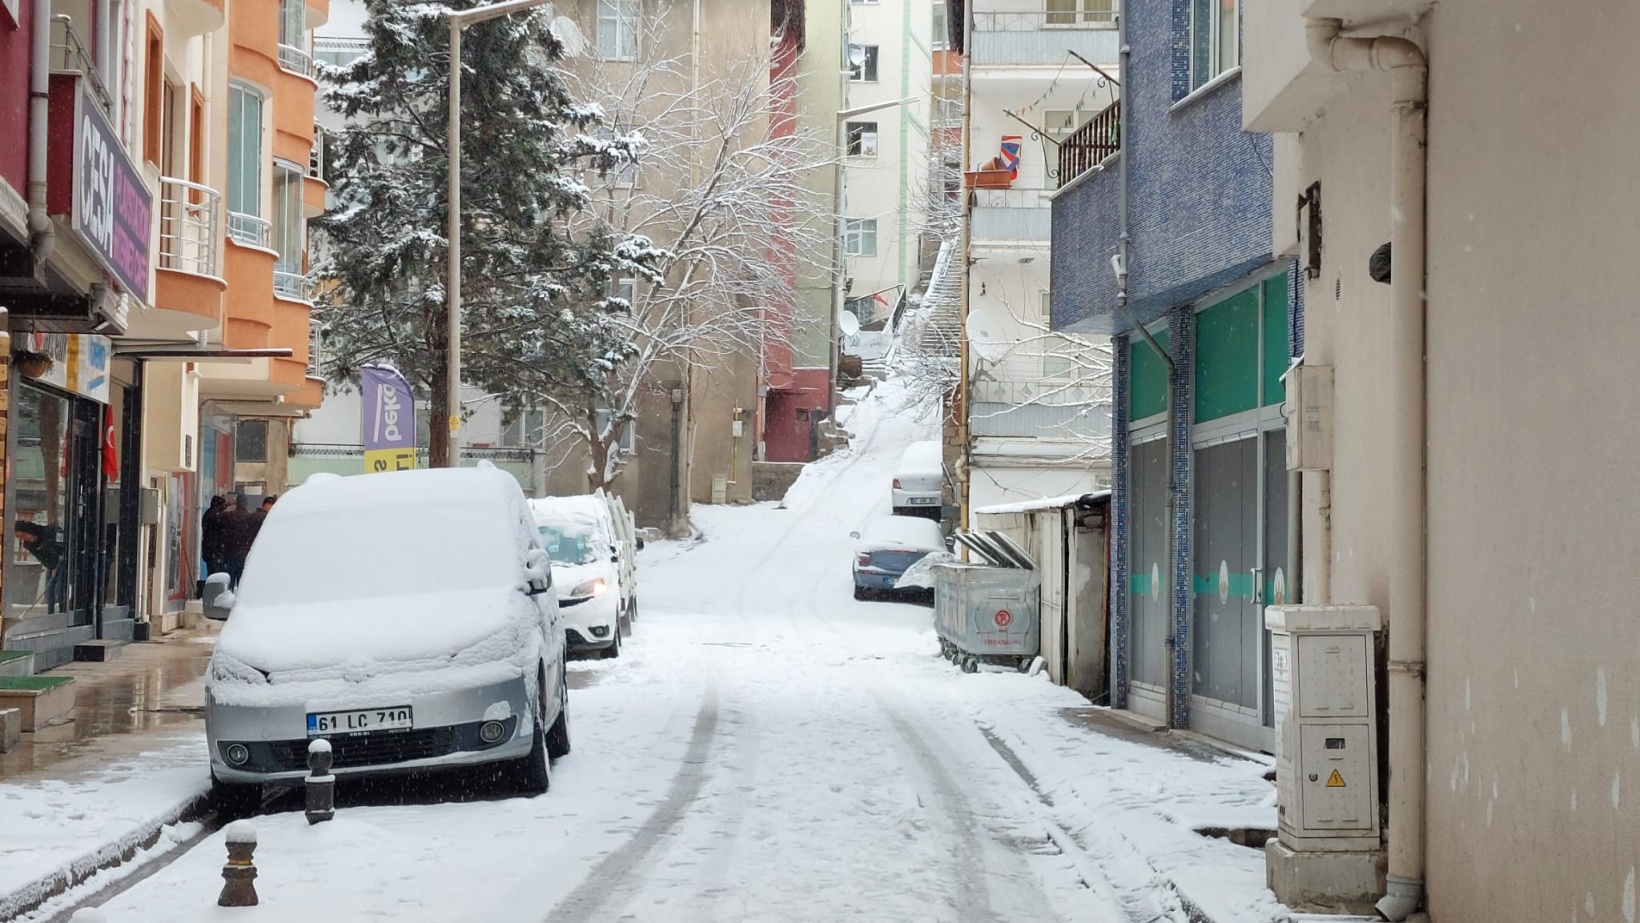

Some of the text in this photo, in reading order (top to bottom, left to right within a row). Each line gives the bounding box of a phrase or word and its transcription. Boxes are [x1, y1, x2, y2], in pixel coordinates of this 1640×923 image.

[81, 114, 115, 259] CESA
[319, 710, 407, 731] 61 LC 710
